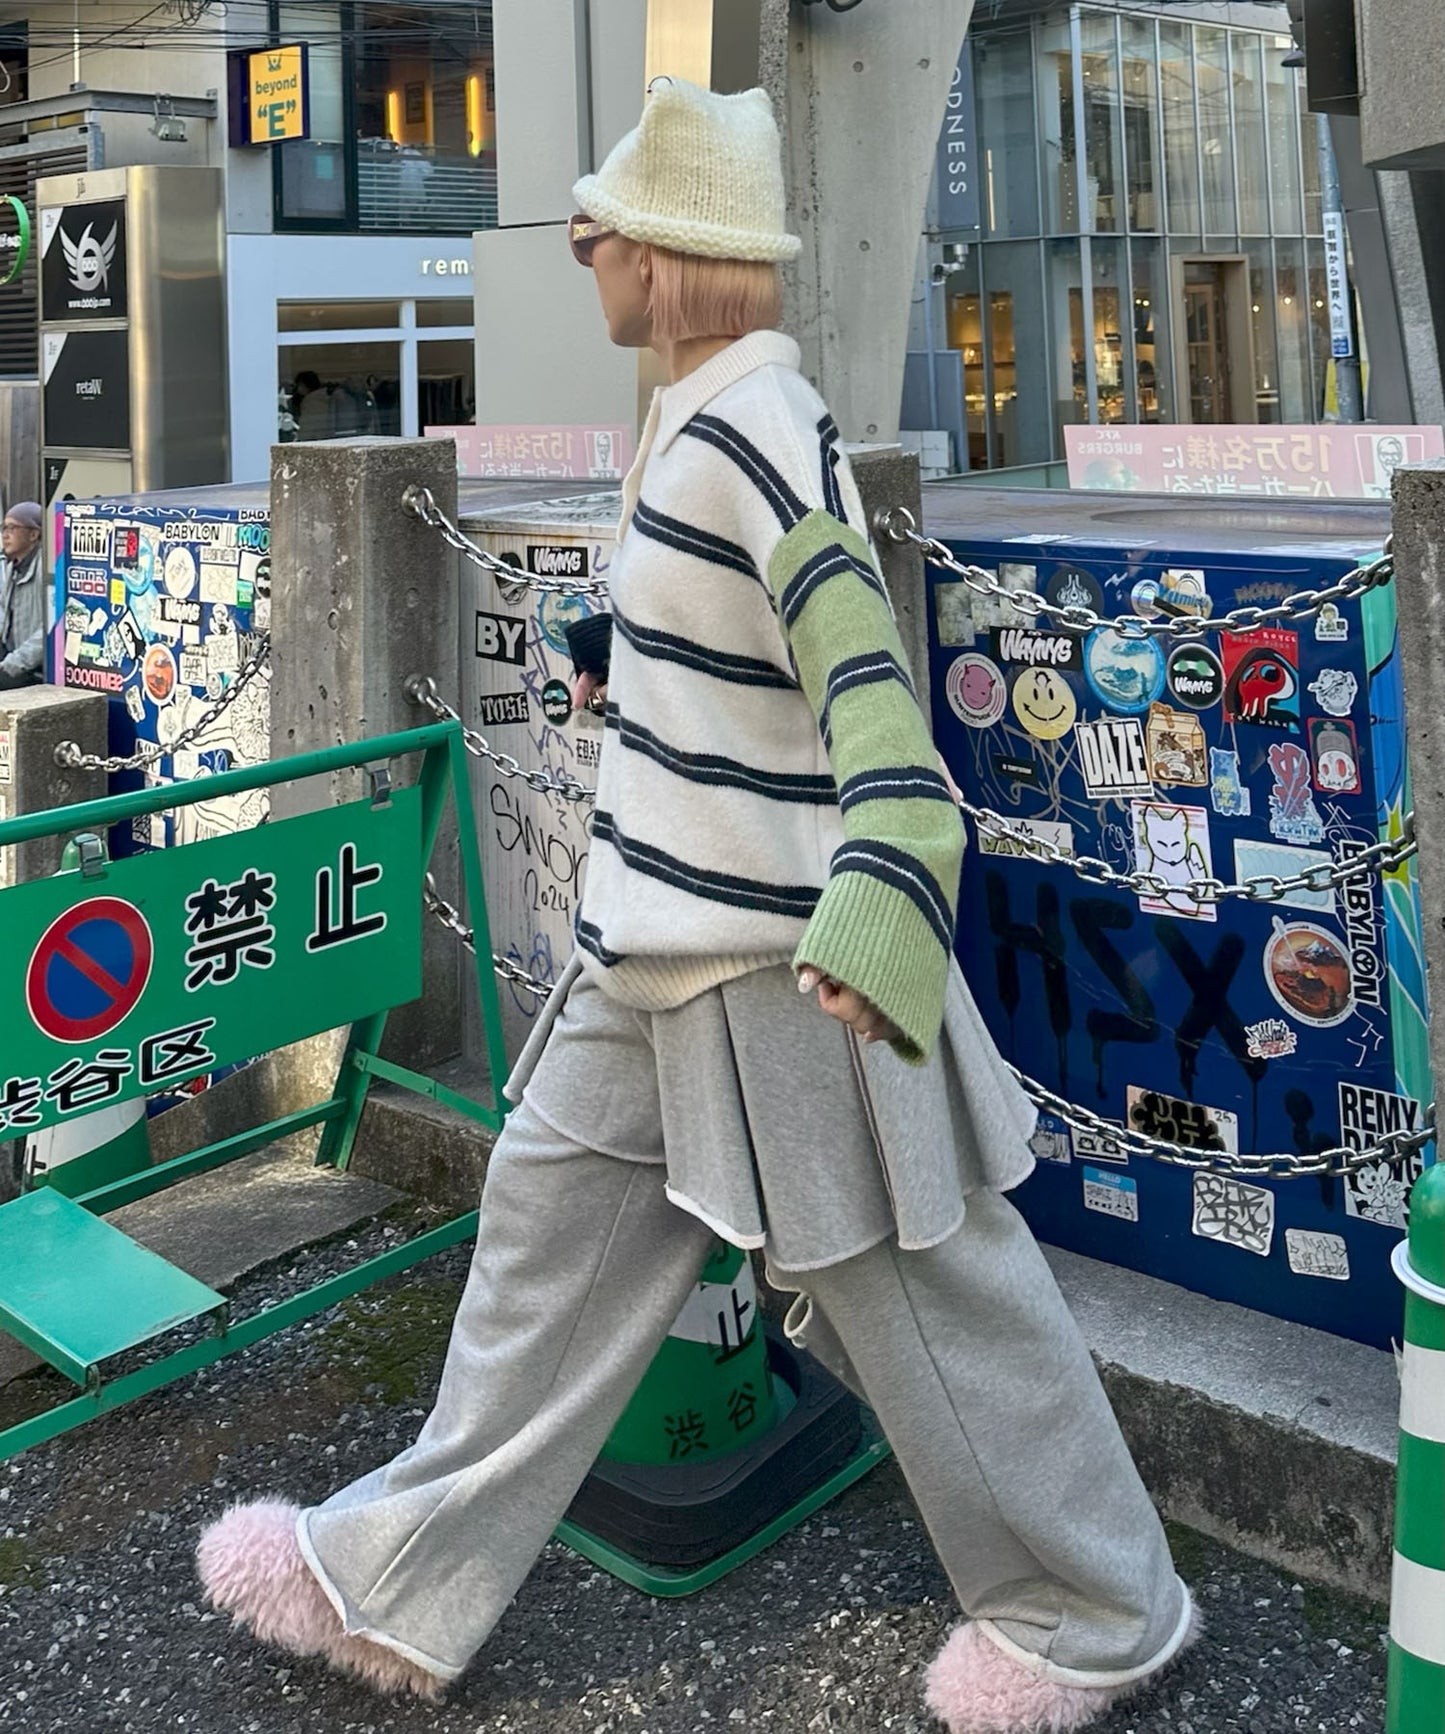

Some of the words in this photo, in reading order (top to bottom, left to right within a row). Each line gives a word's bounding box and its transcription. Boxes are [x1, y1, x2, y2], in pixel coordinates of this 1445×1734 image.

[256, 74, 297, 96] beyond
[422, 258, 474, 275] rem
[76, 379, 102, 395] retaW
[165, 524, 220, 541] BABYLON
[477, 615, 524, 660] BY
[1079, 722, 1149, 785] DAZE
[185, 842, 388, 992] 禁止
[523, 868, 569, 926] 2024
[1340, 1084, 1418, 1132] REMY
